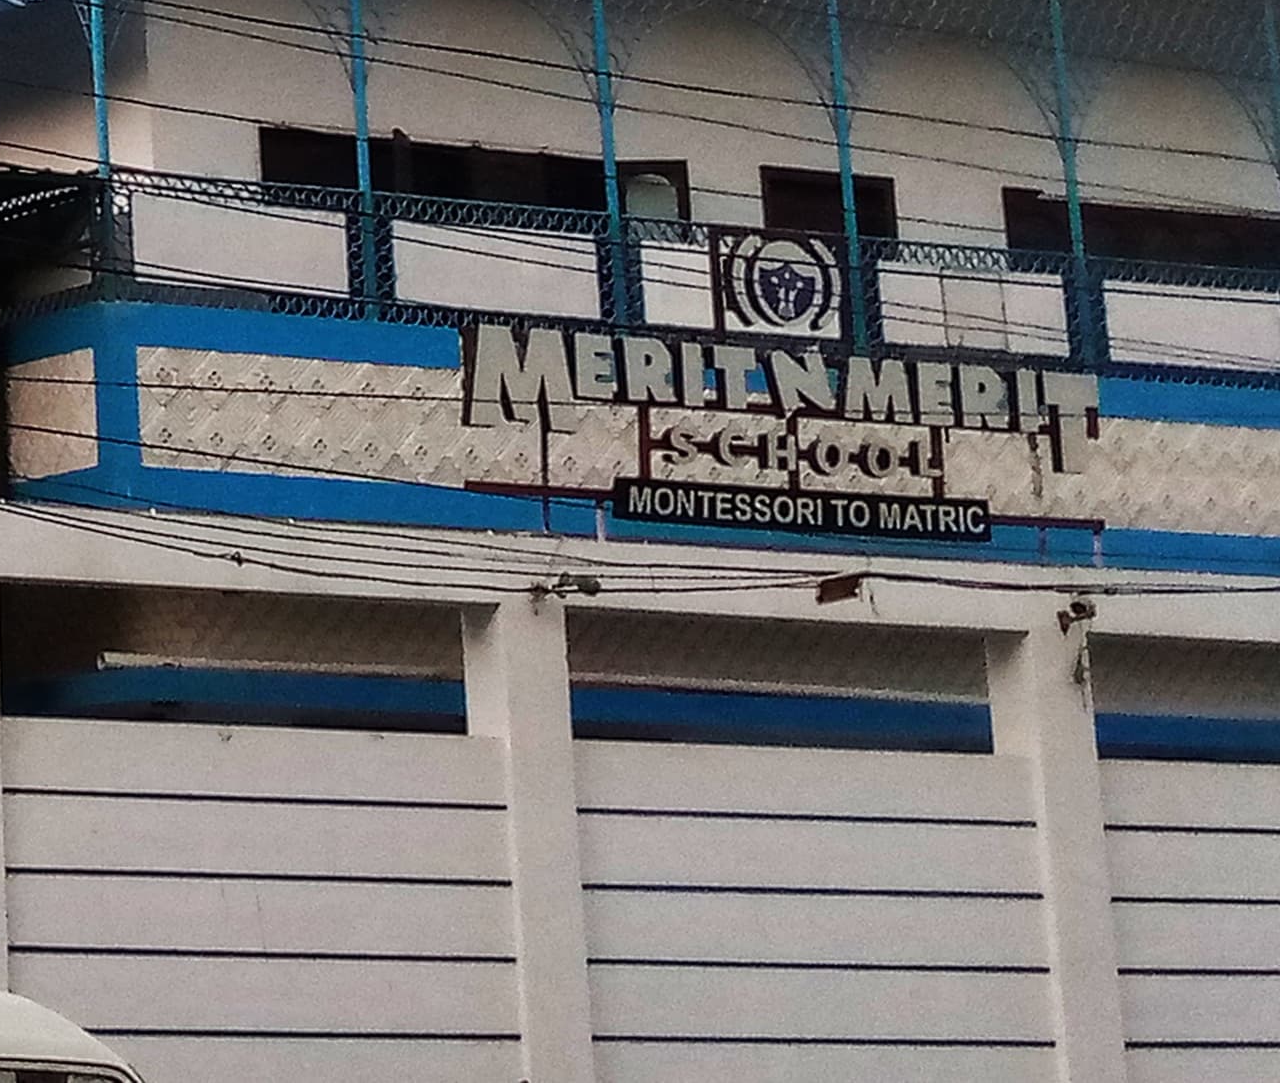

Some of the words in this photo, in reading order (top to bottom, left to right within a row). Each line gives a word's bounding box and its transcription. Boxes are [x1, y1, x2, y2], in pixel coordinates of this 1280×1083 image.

[468, 323, 757, 431] MERIT
[770, 347, 837, 419] N
[844, 356, 1099, 473] MERIT
[669, 427, 944, 478] SCHOOL
[627, 485, 823, 526] MONTESSORI
[830, 500, 869, 527] TO
[879, 503, 986, 533] MATRIC
